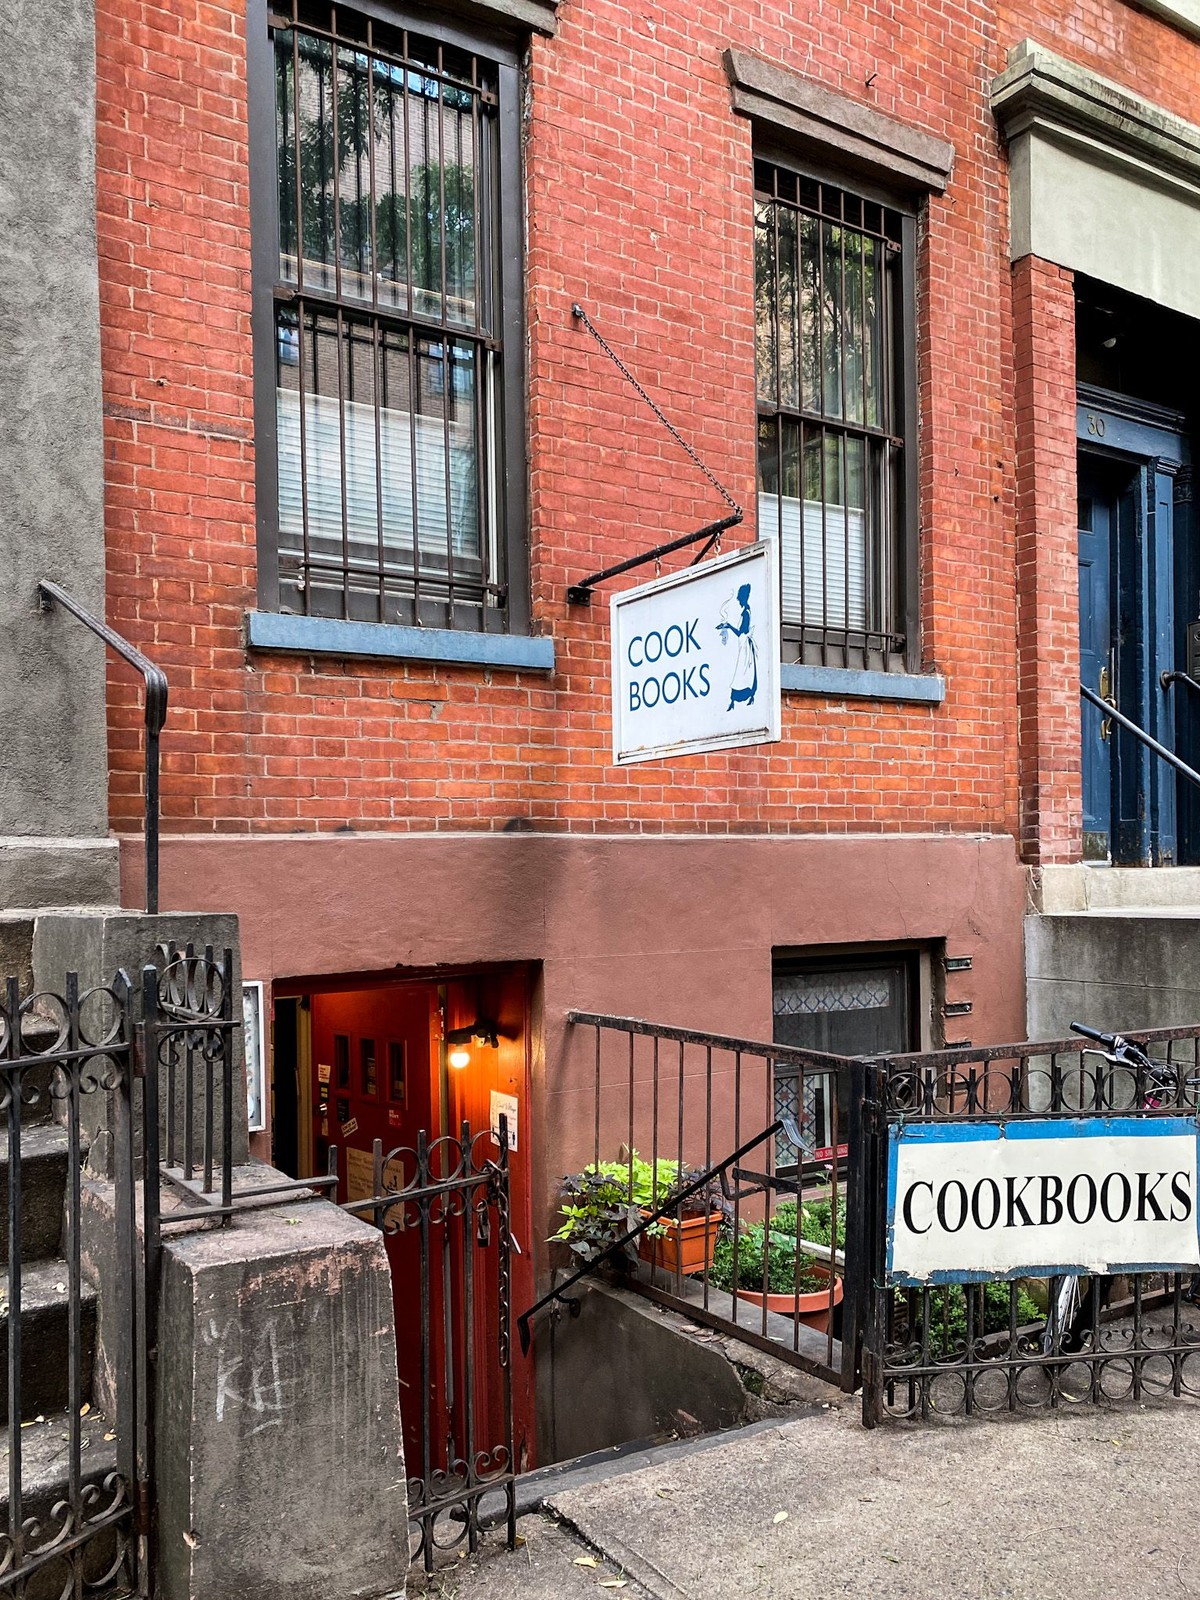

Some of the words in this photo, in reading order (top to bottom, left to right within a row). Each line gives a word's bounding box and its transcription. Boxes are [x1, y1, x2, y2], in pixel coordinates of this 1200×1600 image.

[1087, 414, 1105, 437] 30
[628, 618, 701, 667] COOK
[629, 663, 710, 712] BOOKS
[815, 1150, 823, 1158] NO
[903, 1171, 1192, 1234] COOKBOOKS
